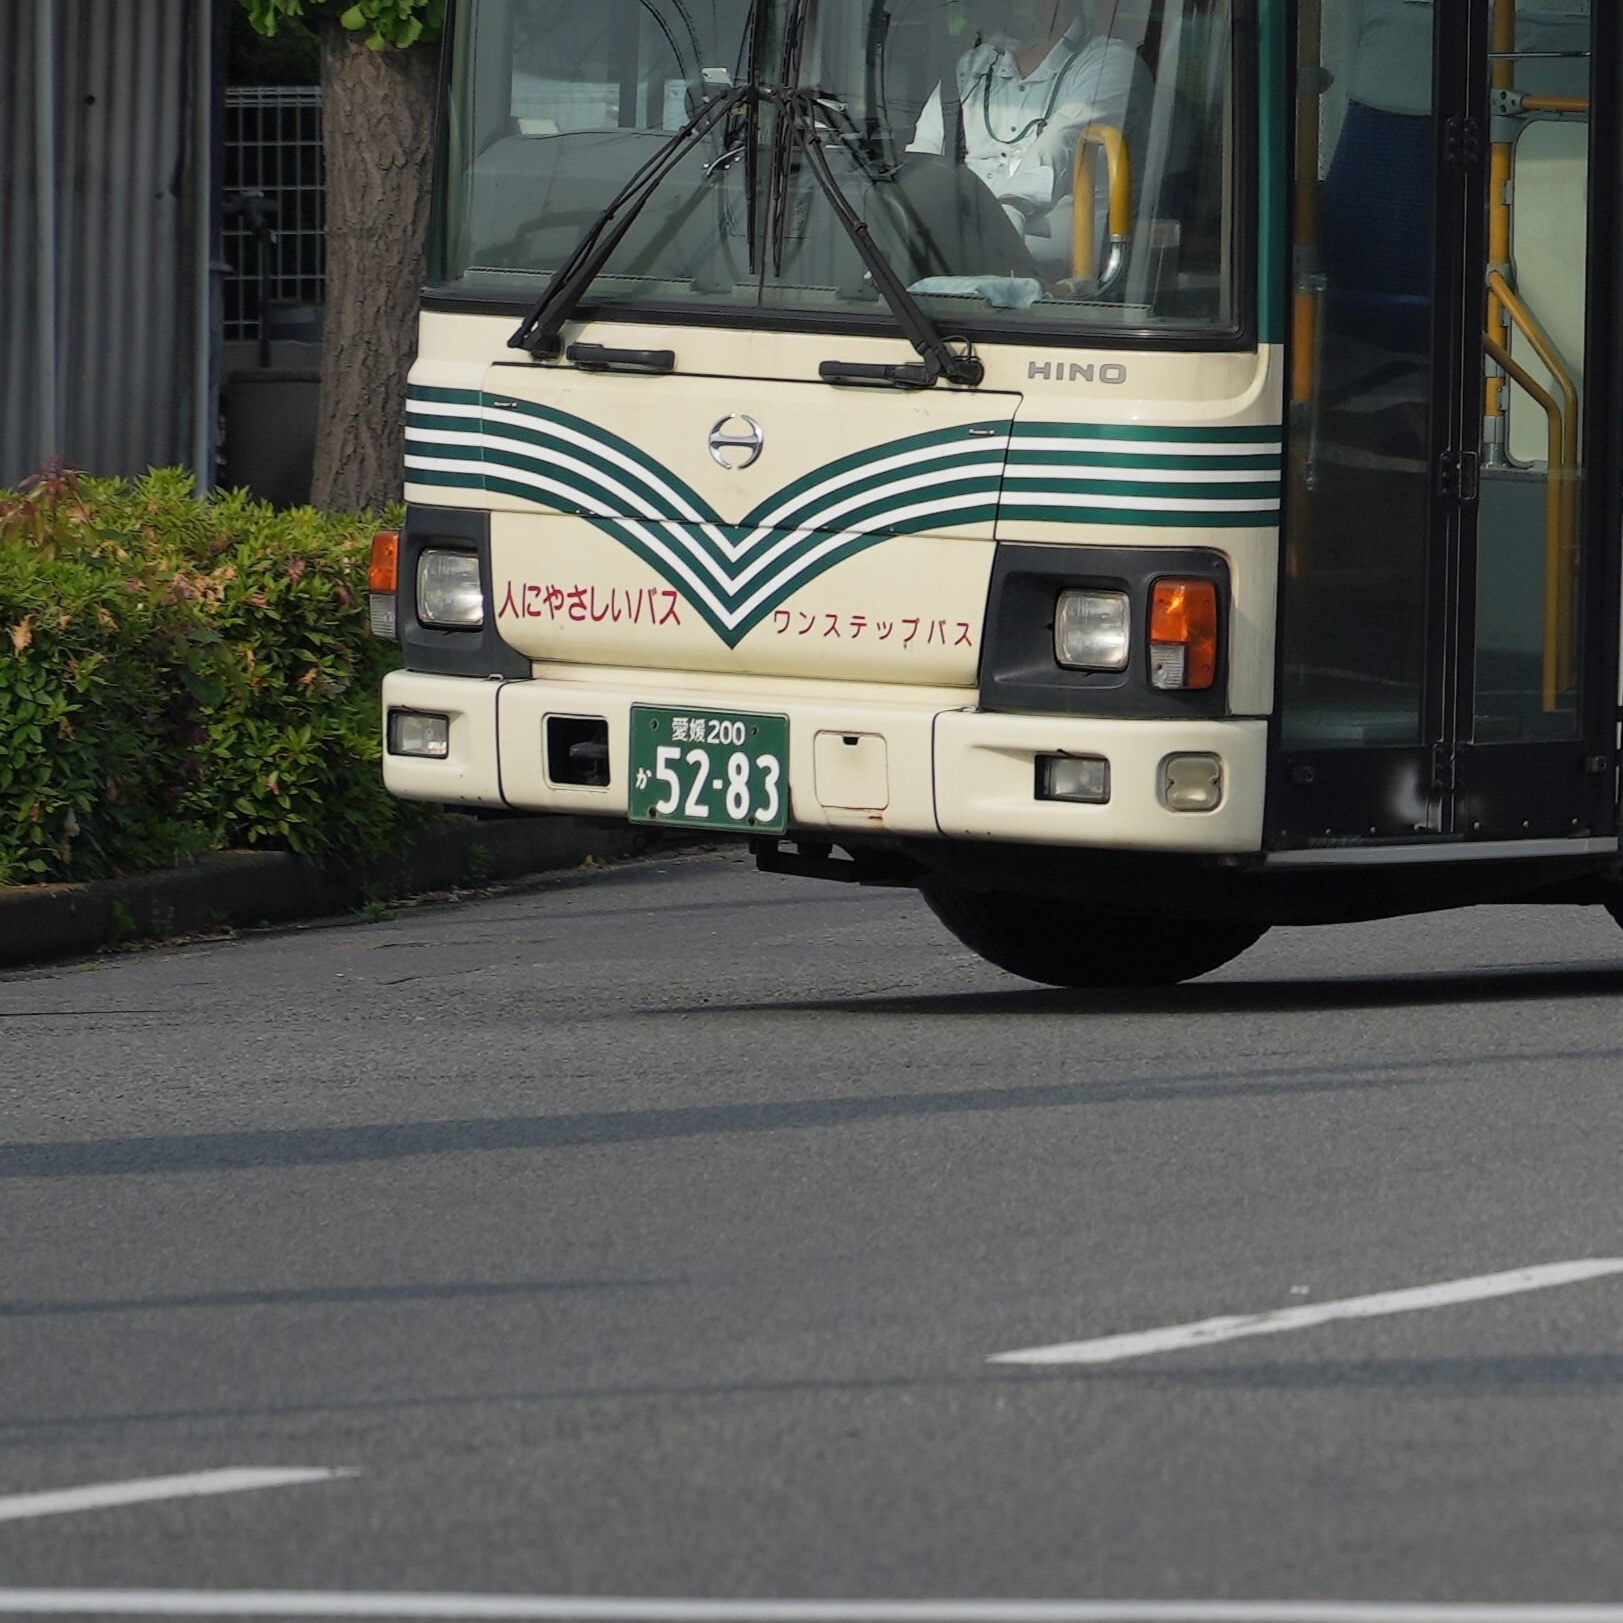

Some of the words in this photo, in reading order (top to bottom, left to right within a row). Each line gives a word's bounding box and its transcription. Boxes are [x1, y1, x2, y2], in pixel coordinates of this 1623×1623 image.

[1028, 361, 1127, 384] HINO
[498, 581, 681, 626] 人にやさしいバス
[773, 609, 973, 647] ワンステップバス
[656, 745, 780, 822] 52-83
